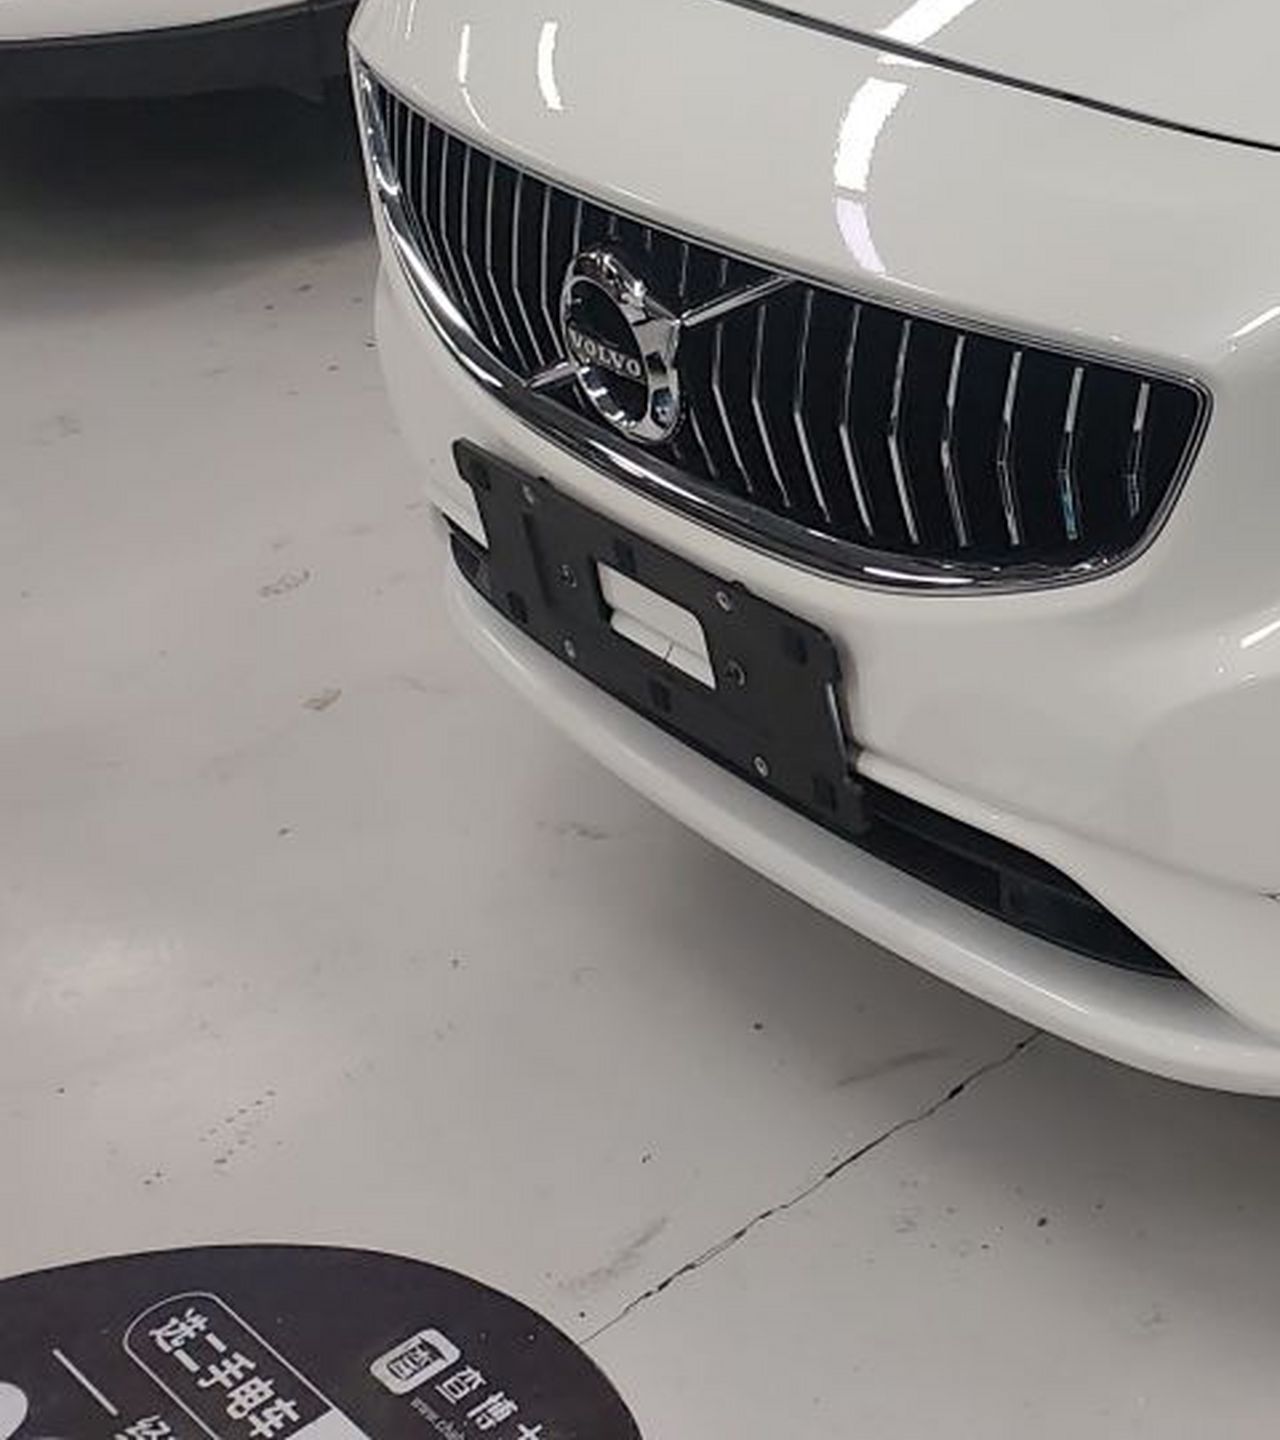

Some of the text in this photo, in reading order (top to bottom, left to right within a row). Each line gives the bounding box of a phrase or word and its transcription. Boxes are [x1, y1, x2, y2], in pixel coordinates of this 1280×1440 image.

[568, 326, 641, 378] VOLVO
[149, 1307, 300, 1438] 选二手电车
